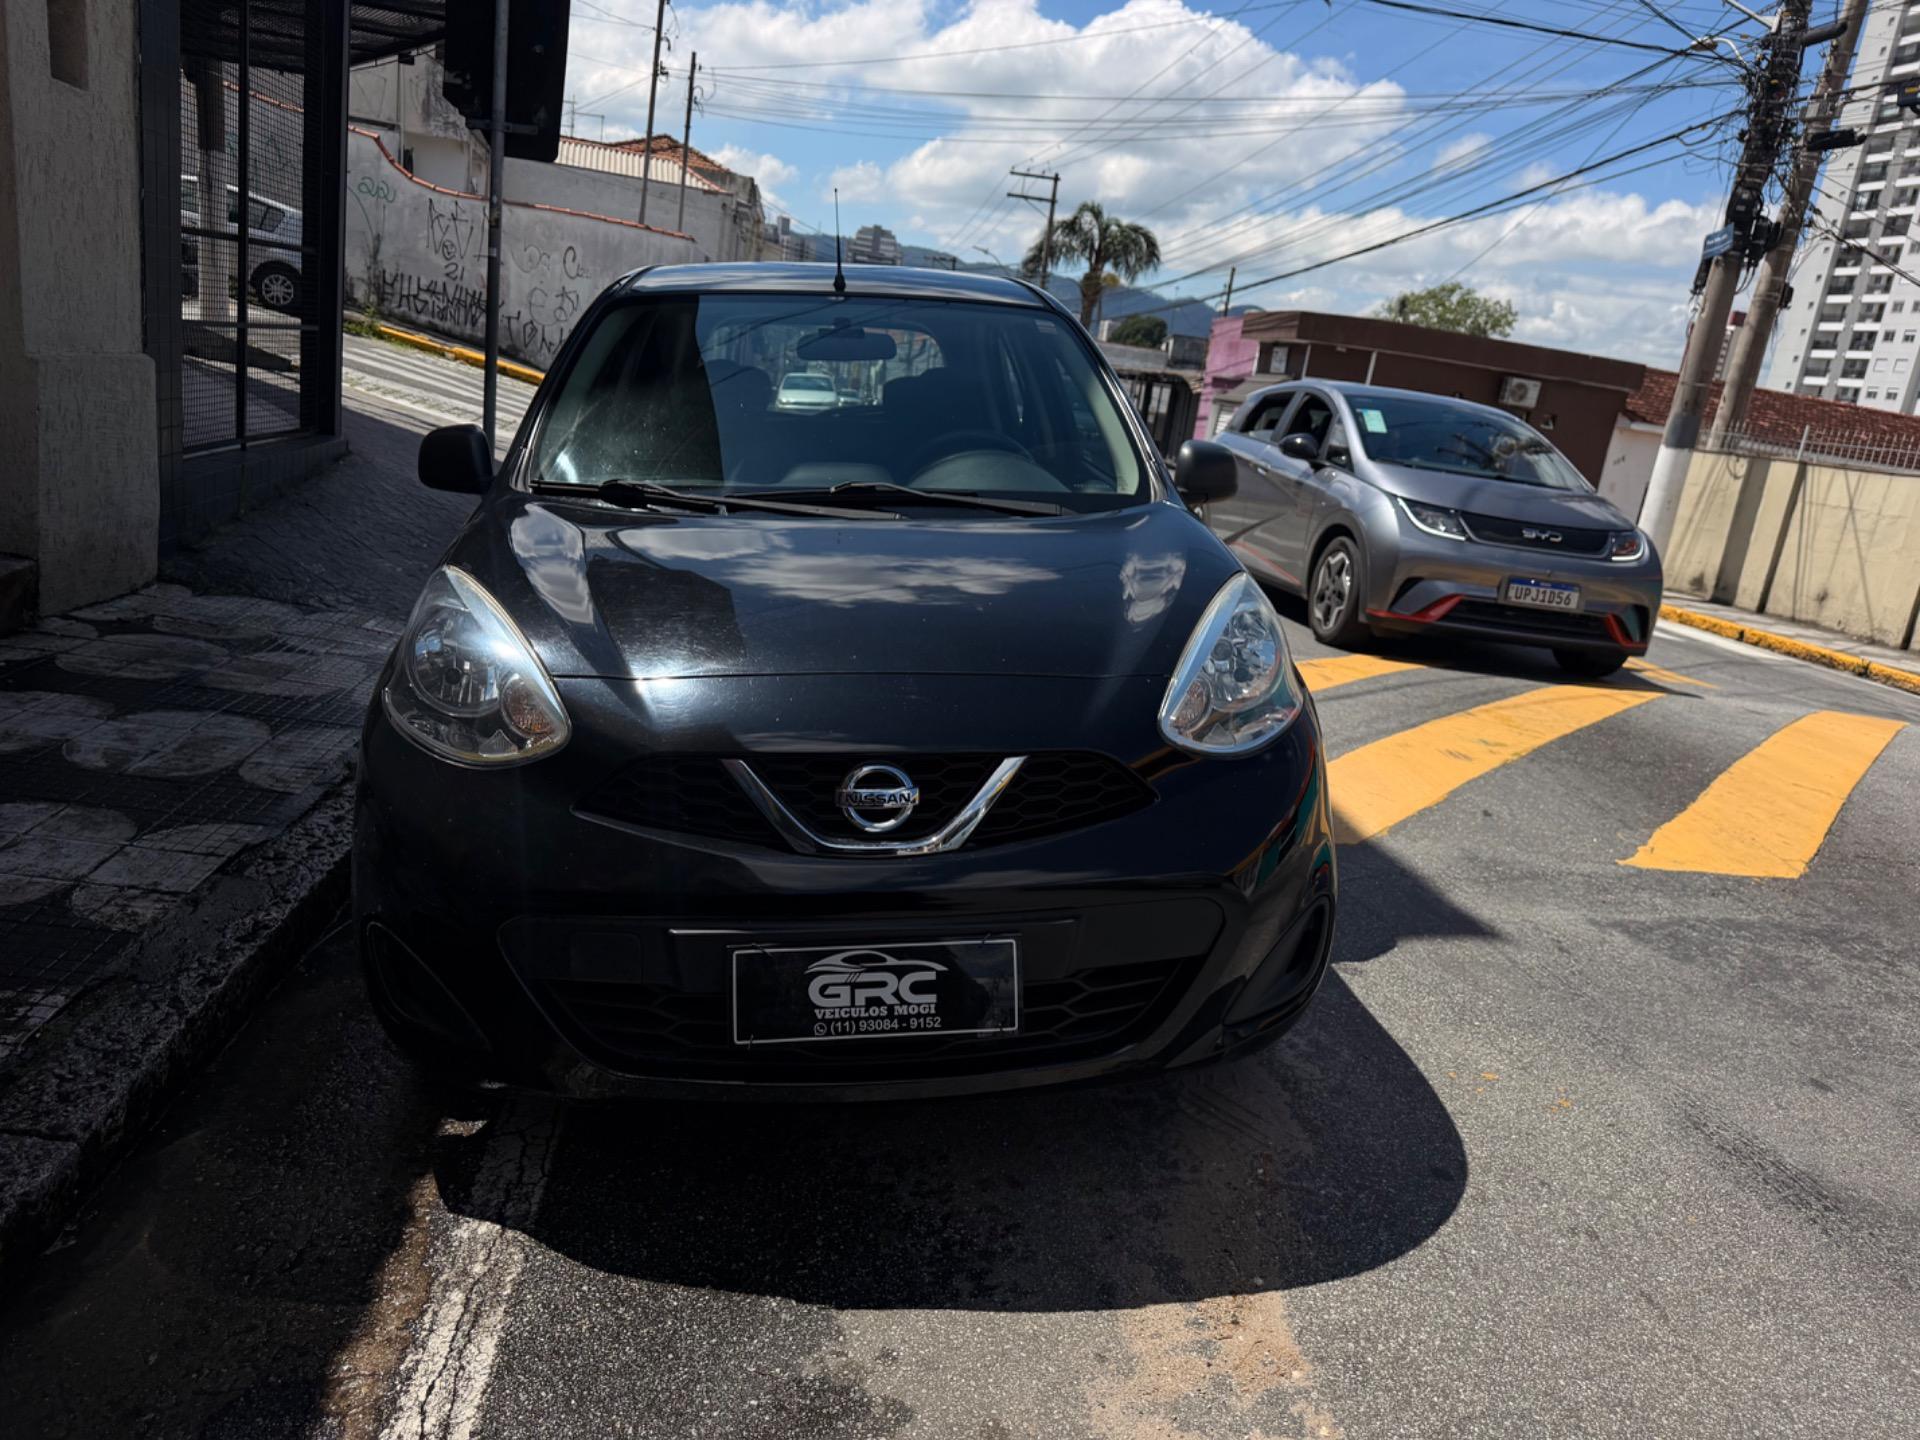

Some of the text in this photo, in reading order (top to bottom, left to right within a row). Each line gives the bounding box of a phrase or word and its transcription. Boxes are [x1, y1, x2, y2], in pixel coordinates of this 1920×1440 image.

[1522, 528, 1562, 542] BYD
[1514, 586, 1572, 606] UPJ1D56
[846, 791, 911, 804] NISSAN
[808, 971, 937, 1008] GRC
[814, 1003, 936, 1019] VEICULOS MOGI
[830, 1021, 855, 1035] (11)
[859, 1018, 898, 1031] 93084
[909, 1016, 941, 1029] 9152
